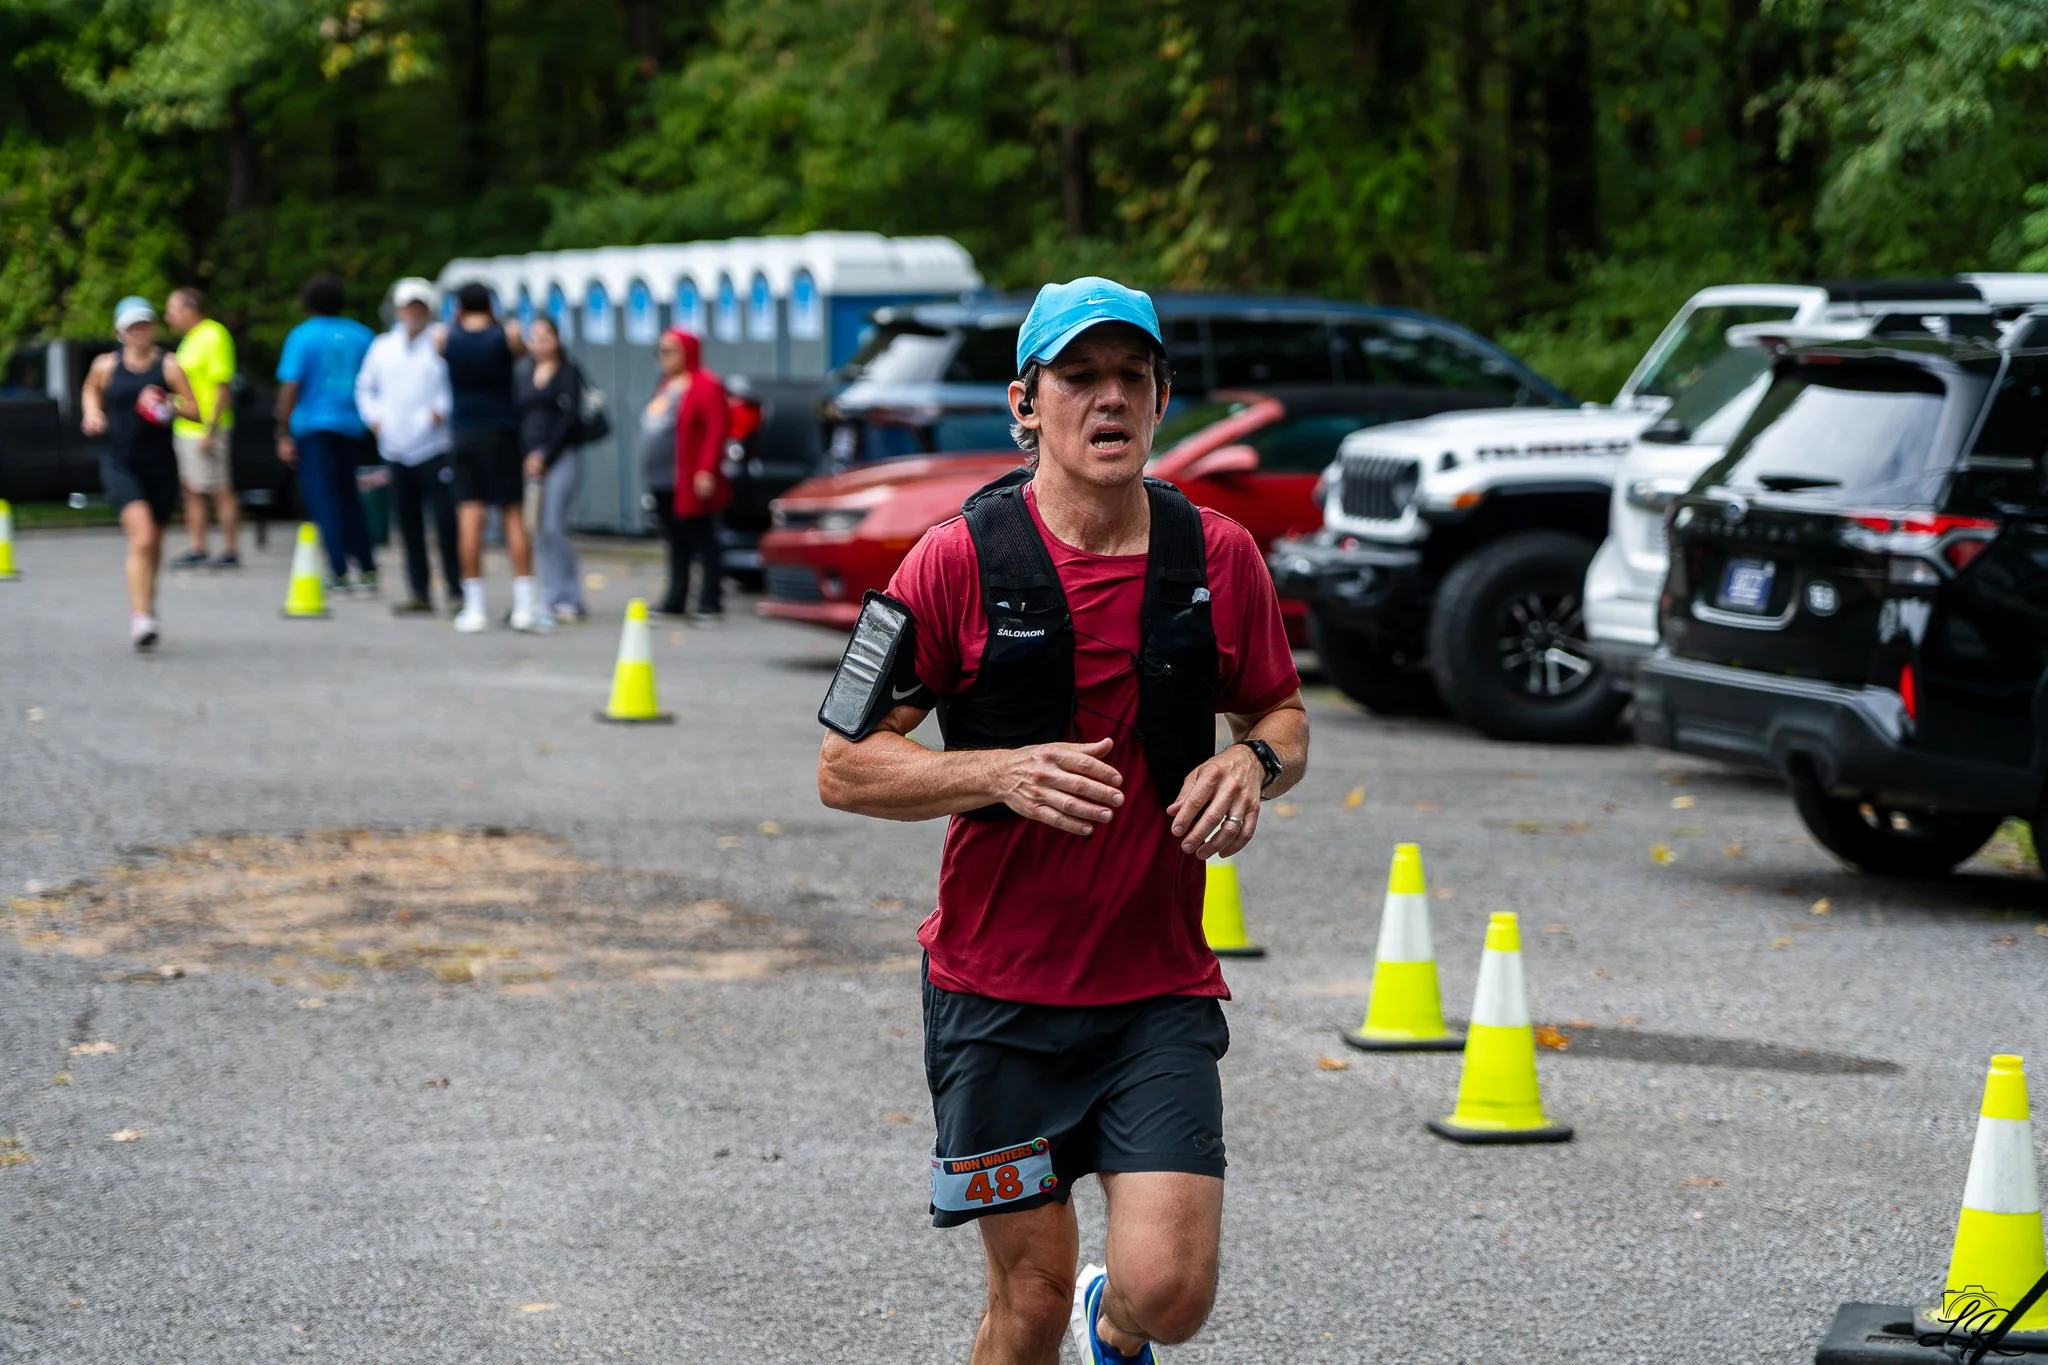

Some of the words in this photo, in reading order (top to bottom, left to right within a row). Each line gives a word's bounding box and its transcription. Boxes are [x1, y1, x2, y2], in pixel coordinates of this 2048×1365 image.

[997, 628, 1045, 638] SALOMON
[952, 1159, 980, 1173] DION
[982, 1145, 1033, 1167] WAITERS
[964, 1164, 1024, 1205] 48
